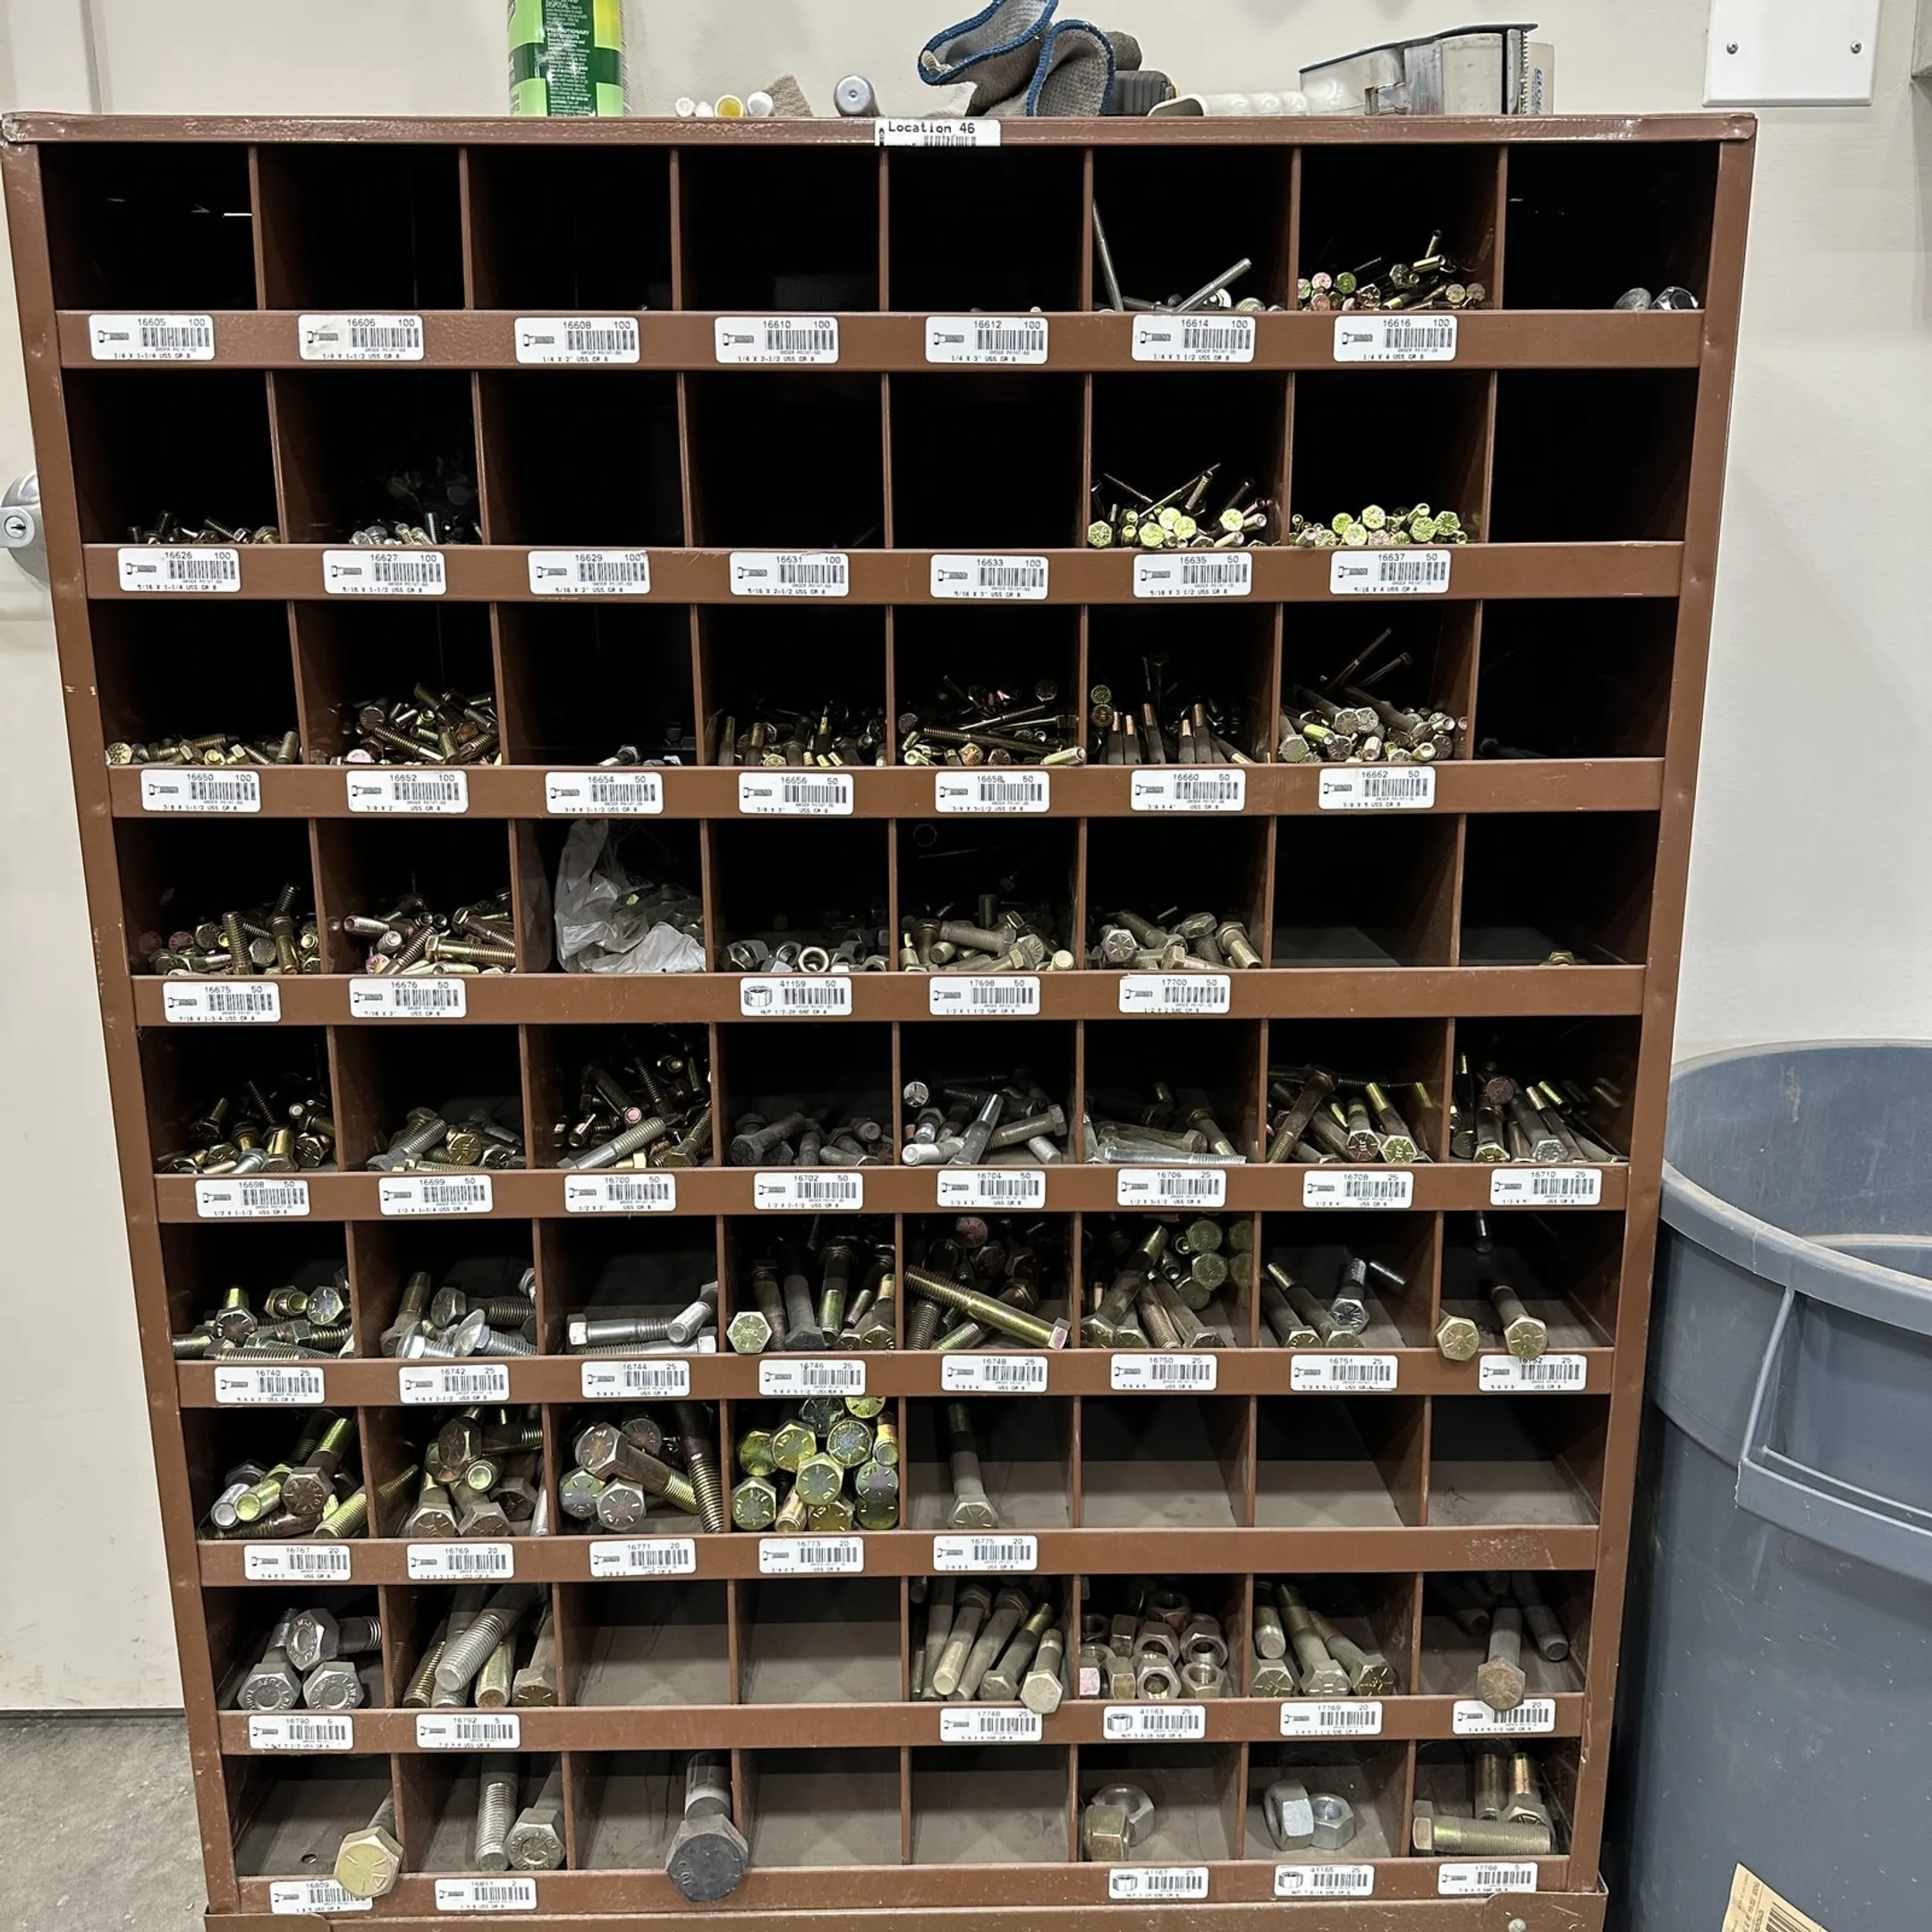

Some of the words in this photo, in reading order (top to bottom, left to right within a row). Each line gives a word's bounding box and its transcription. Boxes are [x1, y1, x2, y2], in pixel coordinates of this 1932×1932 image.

[888, 121, 952, 133] Location
[959, 123, 975, 134] 46
[137, 318, 166, 326] 16605
[814, 321, 831, 329] 100
[974, 321, 1002, 329] 16612
[1024, 321, 1041, 329] 100
[1182, 319, 1209, 327] 16614
[1383, 319, 1411, 327] 16616
[215, 552, 231, 560] 100
[420, 555, 436, 563] 100
[825, 556, 841, 564] 100
[1180, 556, 1207, 564] 16635
[1378, 554, 1405, 562] 16637
[187, 774, 214, 782] 16650
[1174, 774, 1199, 782] 16660
[391, 981, 418, 989] 16676
[204, 986, 232, 994] 16675
[256, 1369, 281, 1377] 16740
